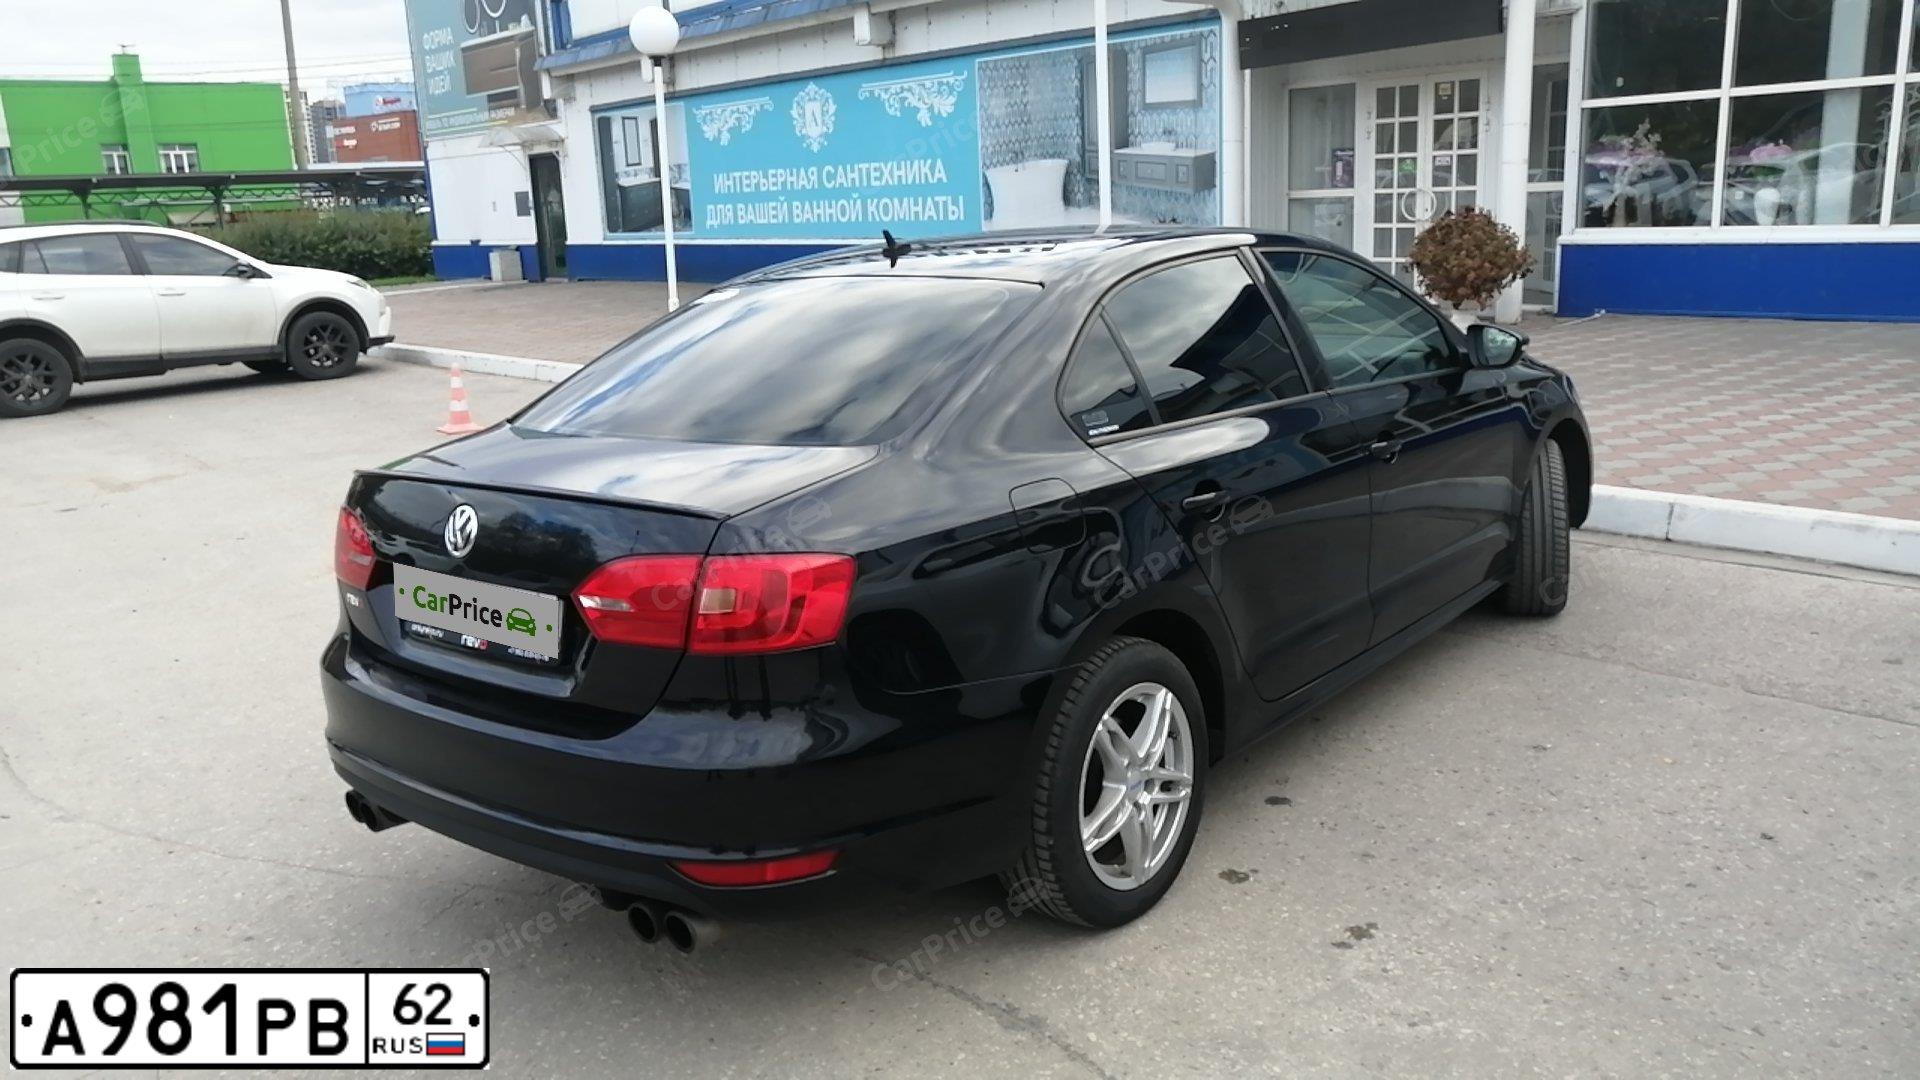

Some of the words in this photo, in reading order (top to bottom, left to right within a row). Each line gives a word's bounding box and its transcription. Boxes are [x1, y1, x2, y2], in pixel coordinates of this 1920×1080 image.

[713, 166, 818, 194] ИНТЕРЬЕРНАЯ
[822, 158, 948, 190] САНТЕХНИКА
[706, 204, 734, 229] ДЛЯ
[737, 196, 788, 225] ВАШЕЙ
[792, 193, 862, 224] ВАННОЙ
[867, 195, 965, 222] КОМНАТЫ
